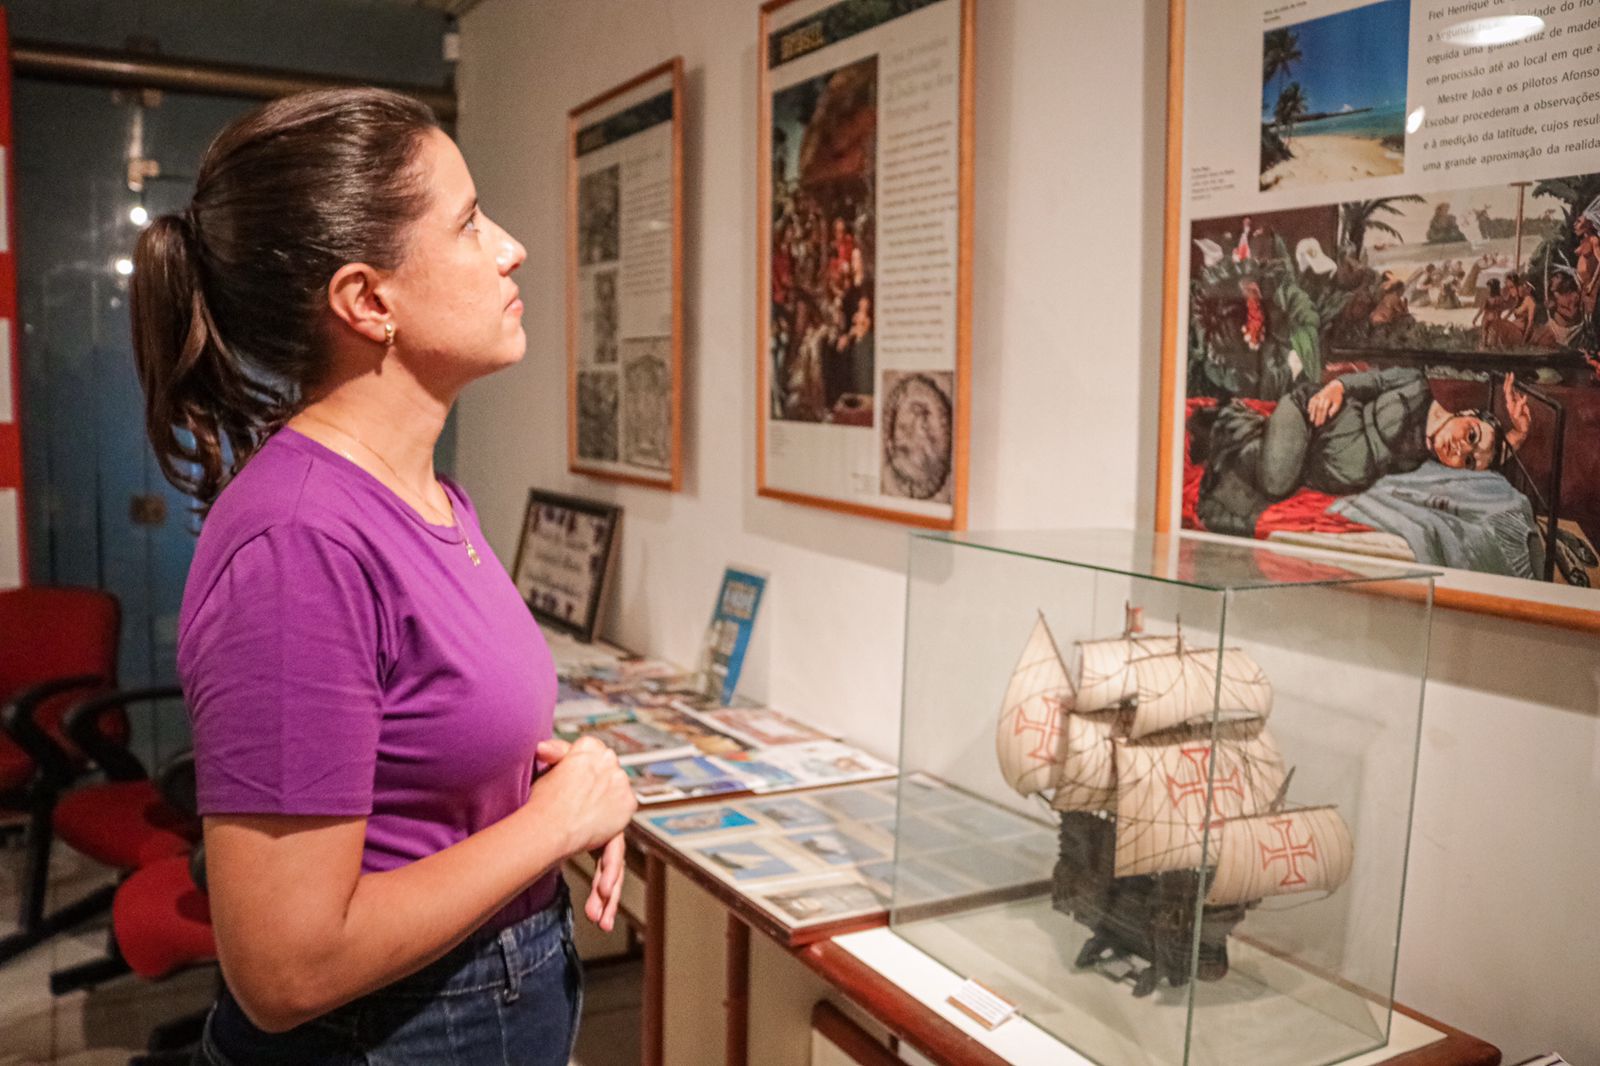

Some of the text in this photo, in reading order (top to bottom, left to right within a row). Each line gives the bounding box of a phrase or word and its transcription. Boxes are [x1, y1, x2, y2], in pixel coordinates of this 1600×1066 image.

[1428, 8, 1444, 20] Frei
[1448, 0, 1489, 15] Henrique
[1560, 1, 1574, 12] do
[1427, 48, 1459, 64] erguida
[1463, 46, 1483, 56] uma
[1549, 26, 1562, 38] de
[1428, 34, 1433, 42] a
[1426, 76, 1439, 85] em
[1441, 66, 1485, 84] procissão
[1489, 61, 1504, 73] até
[1507, 60, 1519, 70] ao
[1523, 52, 1547, 66] local
[1551, 50, 1567, 61] em
[1572, 45, 1592, 59] que
[1438, 68, 1600, 104] Mestre João e os pilotos Afonso
[1424, 91, 1600, 128] Escobar procederam a observações
[1424, 142, 1429, 150] e
[1440, 133, 1479, 146] medição
[1482, 131, 1494, 141] da
[1497, 124, 1537, 139] latitude,
[1541, 120, 1569, 133] cujos
[1573, 113, 1600, 128] resul
[1423, 138, 1600, 172] uma grande aproximação da realida
